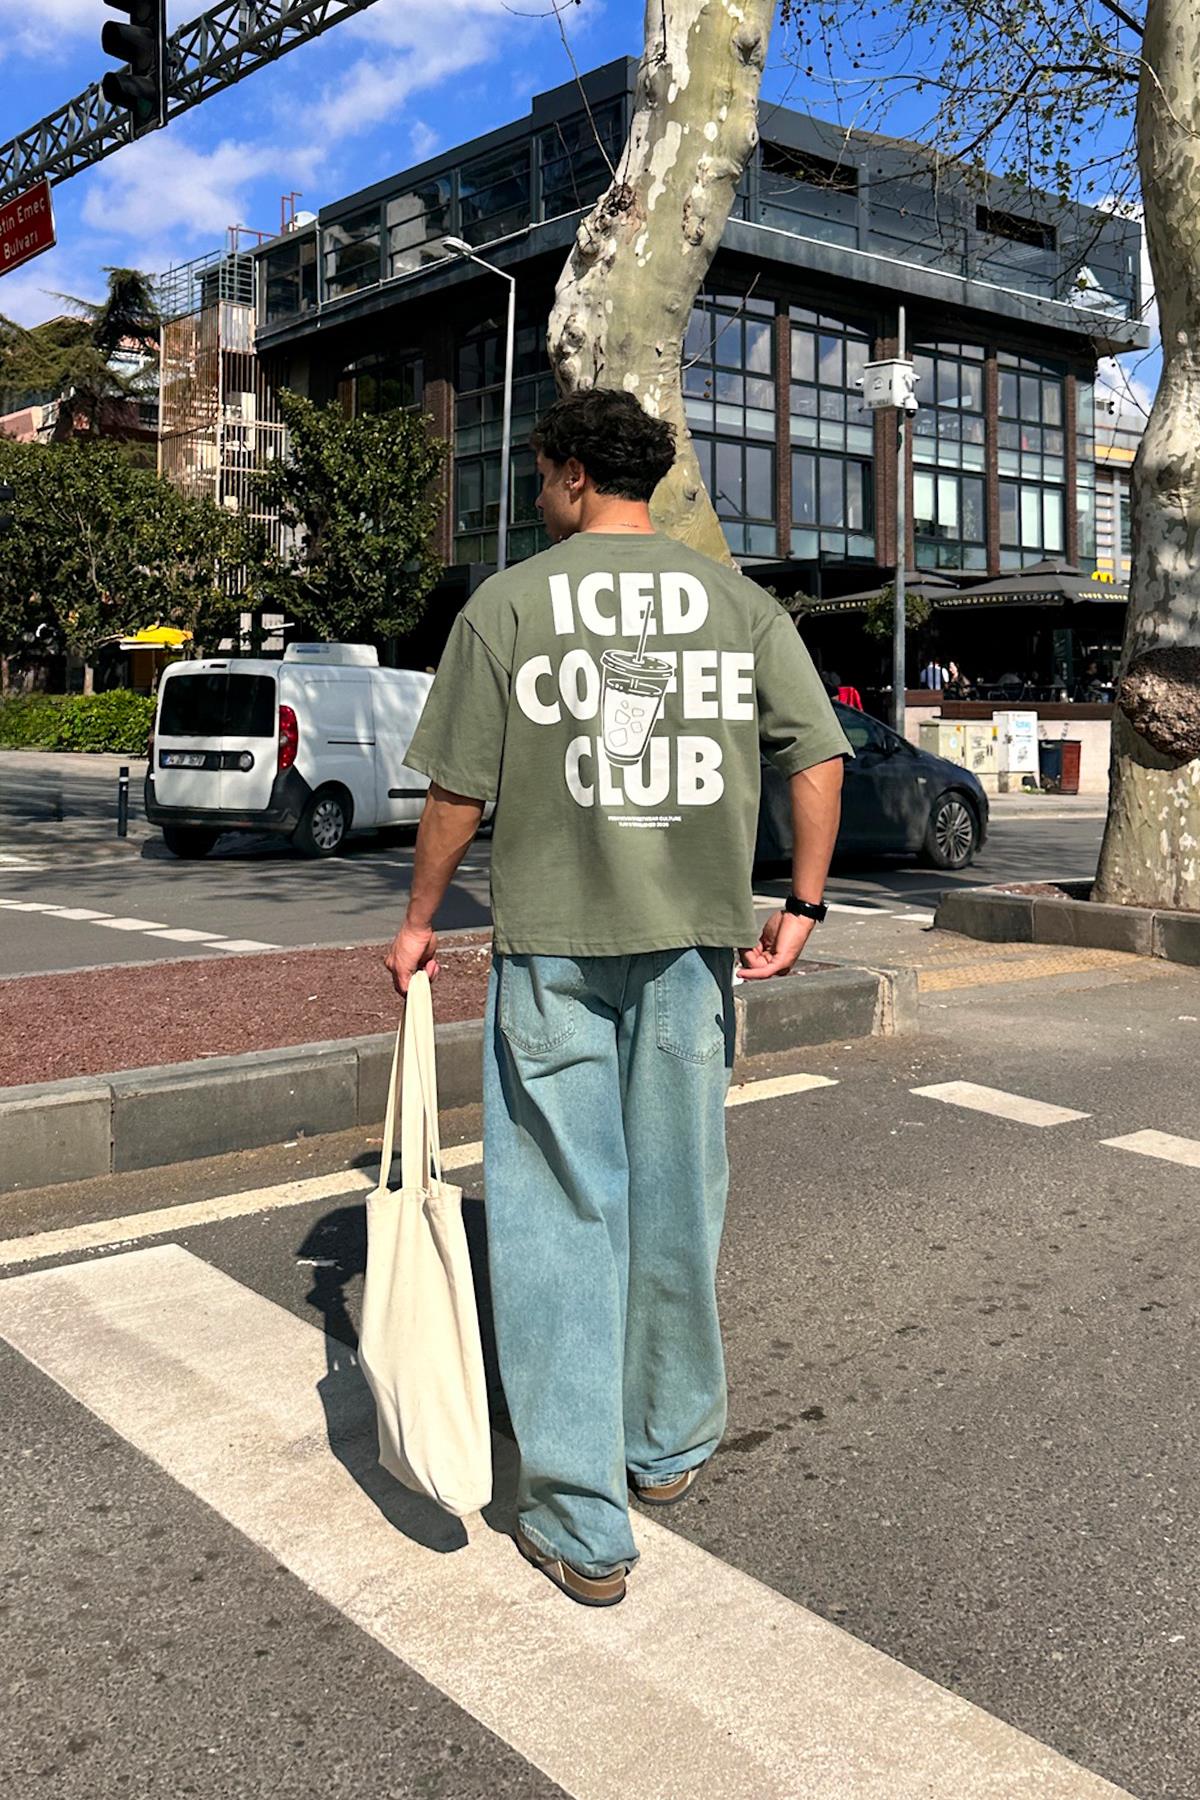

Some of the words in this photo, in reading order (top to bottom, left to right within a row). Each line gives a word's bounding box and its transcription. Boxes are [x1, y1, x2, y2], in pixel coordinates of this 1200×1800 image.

[17, 197, 45, 223] Emeç
[549, 572, 709, 636] ICED
[515, 648, 755, 726] COEE
[564, 735, 725, 808] CLUB
